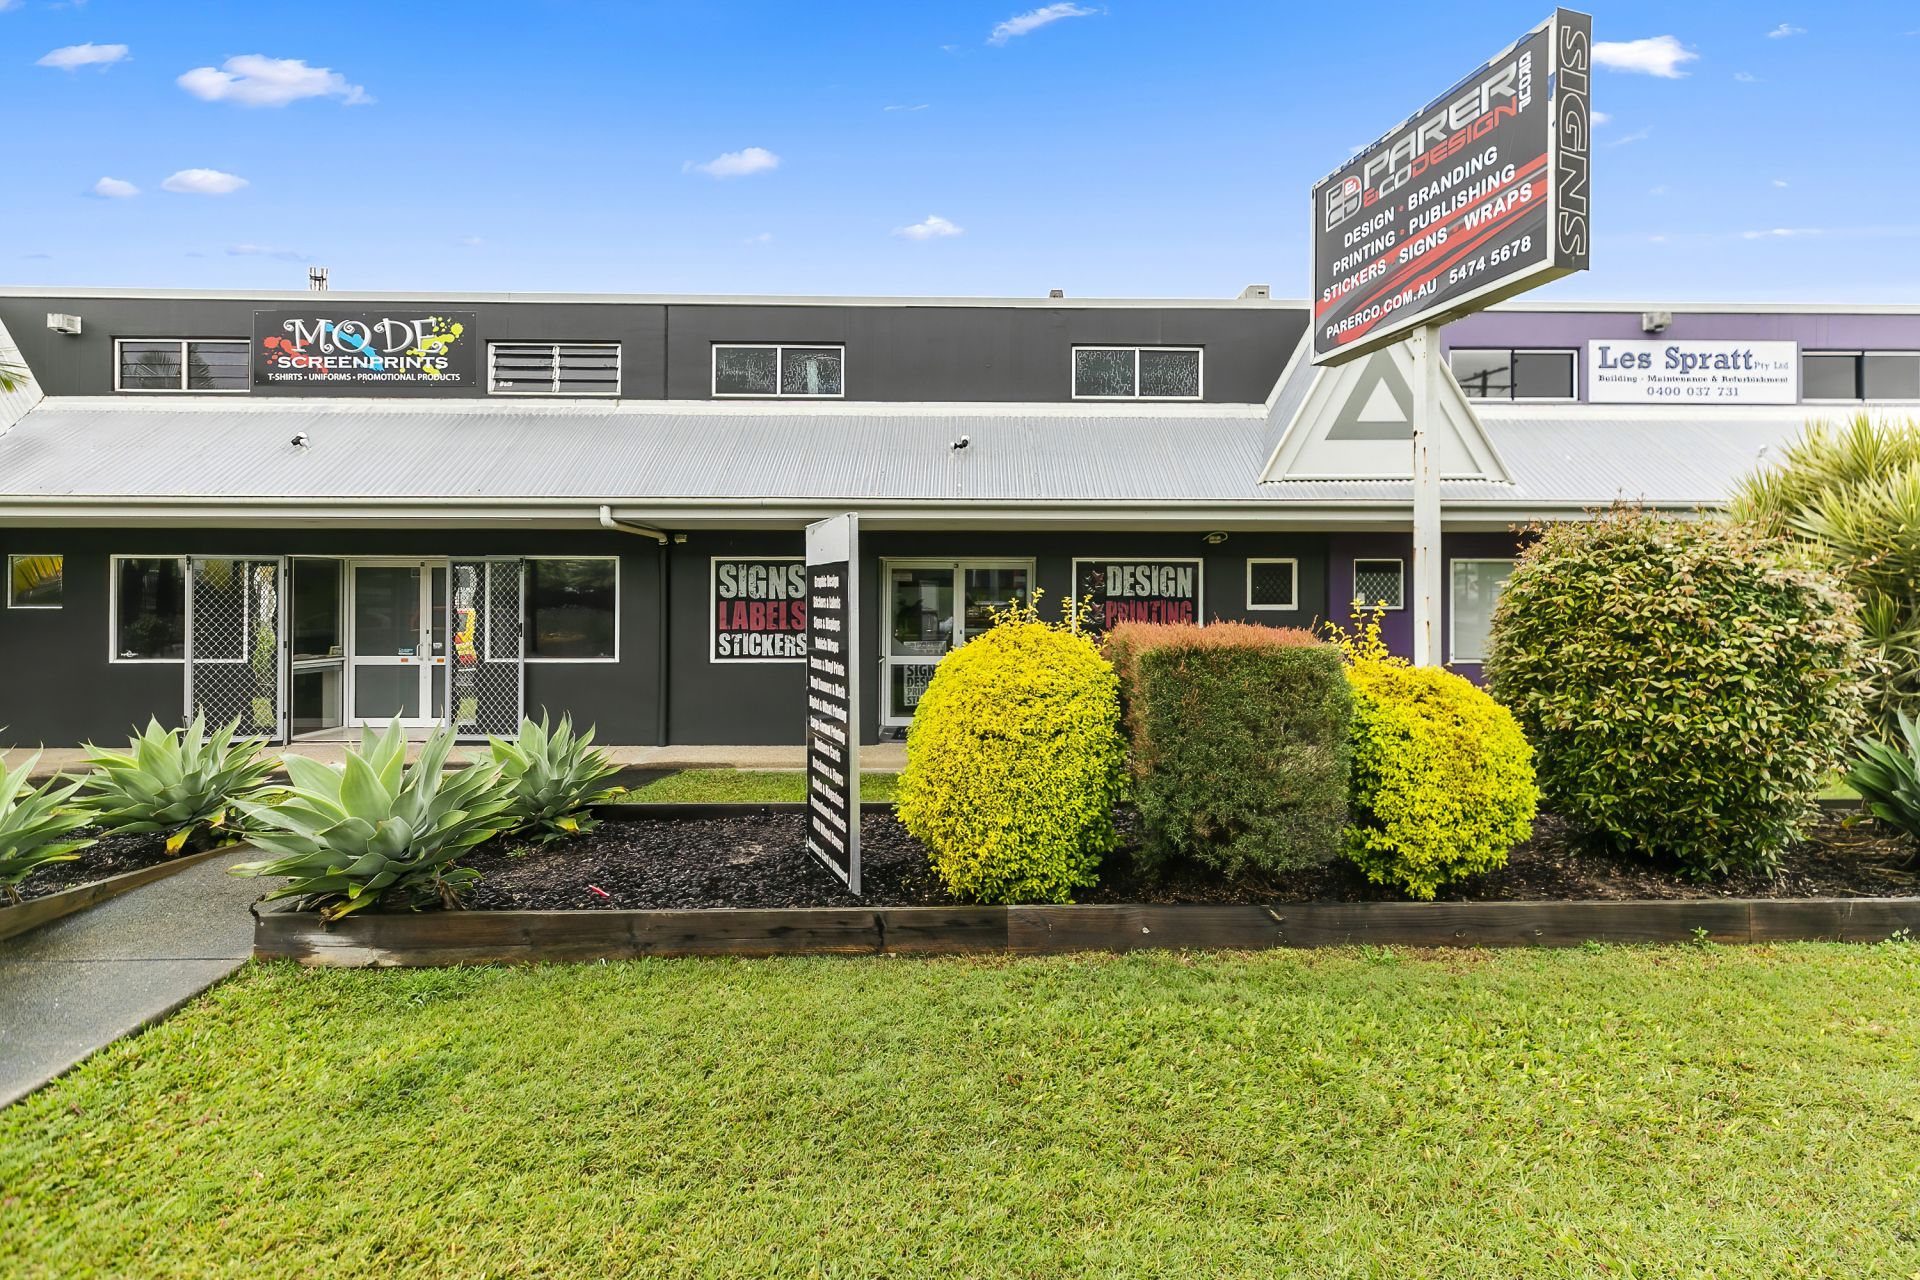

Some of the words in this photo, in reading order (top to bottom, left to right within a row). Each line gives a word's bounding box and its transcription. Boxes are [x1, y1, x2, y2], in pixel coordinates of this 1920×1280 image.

[1518, 50, 1531, 113] GROUP
[1363, 61, 1517, 190] PARER
[1559, 26, 1588, 255] SIGNS
[1344, 206, 1395, 248] DESIGN
[1408, 146, 1498, 211] BRANDING
[1333, 231, 1396, 277] PRINTING
[1409, 163, 1516, 235] PUBLISHING
[1323, 259, 1386, 303] STICKERS
[1399, 227, 1448, 264] SIGNS
[1464, 182, 1533, 231] WRAPS
[1326, 278, 1437, 339] PARERCO.COM.AU
[1449, 255, 1486, 284] 5474
[1490, 235, 1532, 266] 5678
[283, 318, 445, 354] MODE
[268, 373, 303, 381] T-SHIRTS
[308, 373, 351, 381] UNIFORMS
[357, 373, 416, 381] PROMOTIONAL
[417, 373, 461, 381] PRODUCTS
[277, 355, 449, 369] SCREENPRINTS
[1598, 346, 1652, 369] Les
[1665, 346, 1753, 374] Spratt
[1754, 361, 1768, 371] Pty
[1773, 361, 1789, 370] Ltd
[1598, 375, 1638, 383] Building
[1647, 386, 1681, 396] 0400
[1686, 387, 1710, 396] 037
[1717, 387, 1739, 396] 731
[719, 563, 806, 600] SIGNS
[1106, 565, 1193, 598] DESIGN
[719, 601, 806, 631] LABELS
[1105, 600, 1193, 628] PRINTING
[718, 633, 807, 657] STICKERS
